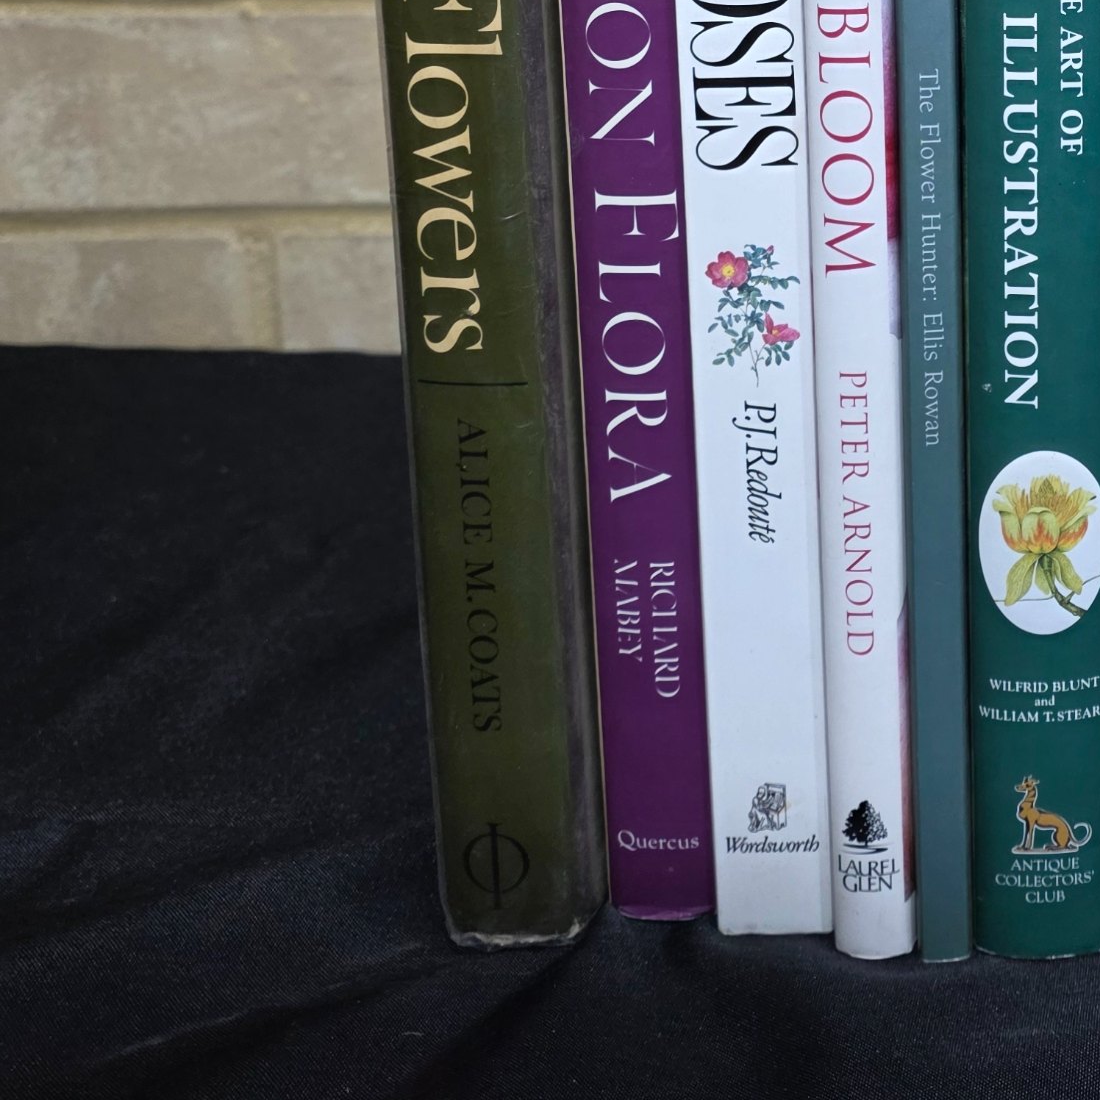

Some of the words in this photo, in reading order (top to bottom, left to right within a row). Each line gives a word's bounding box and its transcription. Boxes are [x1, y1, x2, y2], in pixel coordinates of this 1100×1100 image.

[919, 68, 940, 114] The
[1060, 27, 1084, 97] ART
[817, 3, 876, 278] BLOOM
[1060, 109, 1084, 156] OF
[920, 122, 941, 204] Flower
[1003, 12, 1039, 409] ILLUSTRATION
[922, 212, 941, 301] Hunter:
[594, 189, 680, 503] FLORA
[923, 313, 944, 361] Ellis
[839, 370, 870, 483] PETER
[925, 371, 943, 447] Rowan
[458, 419, 492, 544] ALICE
[842, 495, 875, 655] ARNOLD
[613, 559, 642, 662] MABEY
[649, 560, 681, 698] RICHARD
[979, 705, 1039, 723] WILLIAM
[989, 678, 1049, 693] WILFRID
[1051, 676, 1100, 692] BLUNT
[1034, 695, 1055, 707] and
[616, 829, 700, 851] Quercus
[726, 834, 819, 855] Wordsworth
[838, 856, 900, 876] LAUREL
[1011, 857, 1079, 872] ANTIQUE
[842, 873, 893, 892] GLEN
[1026, 890, 1064, 903] CLUB
